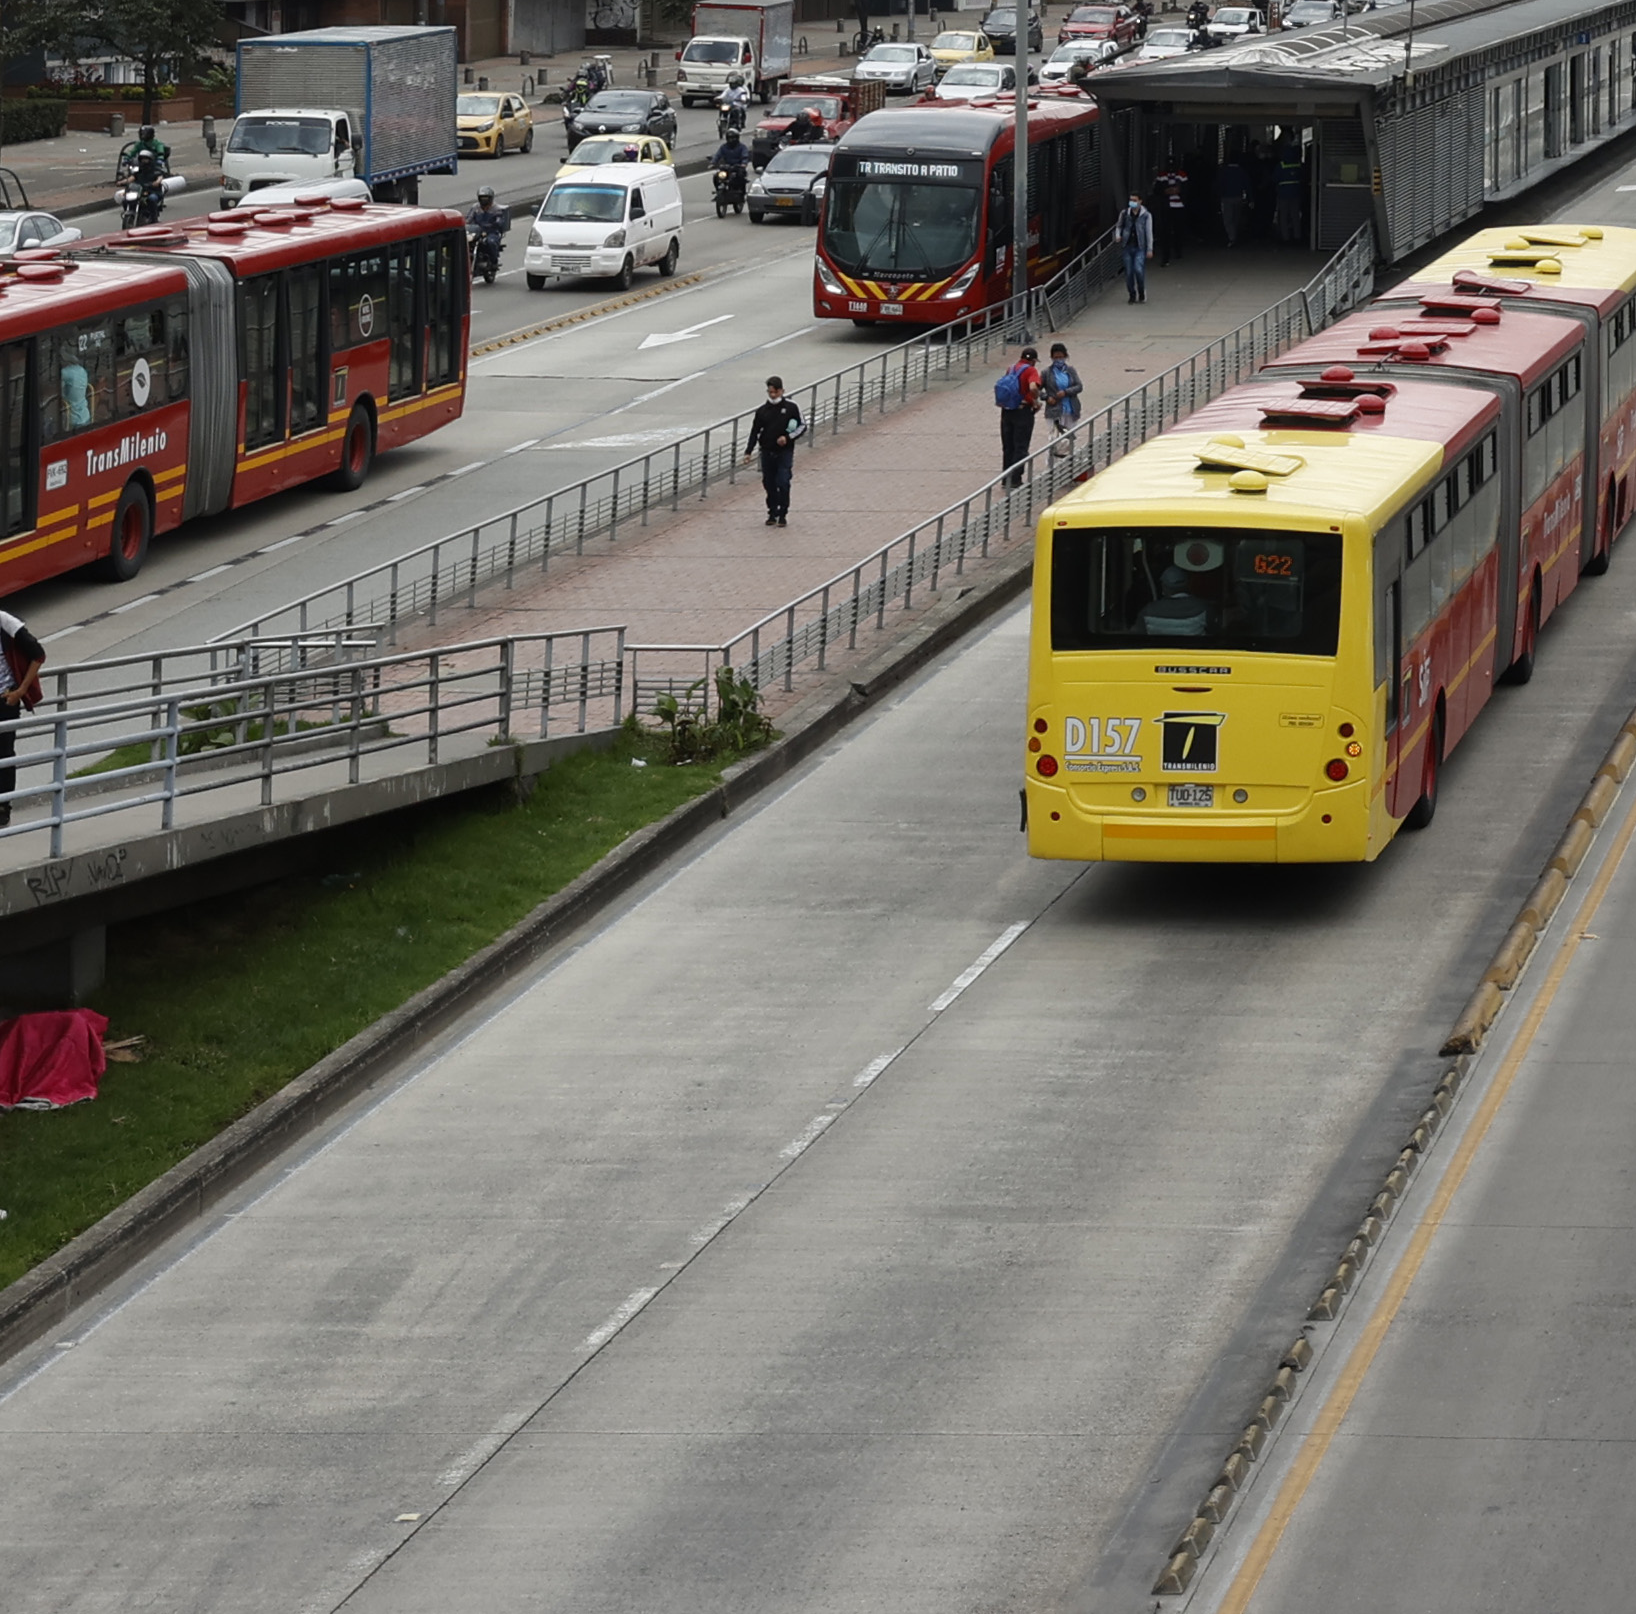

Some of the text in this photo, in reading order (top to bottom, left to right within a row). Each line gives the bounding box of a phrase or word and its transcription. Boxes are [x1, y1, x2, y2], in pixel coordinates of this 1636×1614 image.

[859, 161, 959, 177] TR TRANSITO A PATIO
[86, 428, 167, 476] TransMilenio
[1255, 554, 1293, 575] G22
[1157, 666, 1229, 674] BUSSCAR
[1065, 717, 1142, 754] D157
[1064, 761, 1097, 772] Consorcio
[1097, 761, 1122, 774] Express
[1163, 762, 1216, 770] TRANSMILENIO
